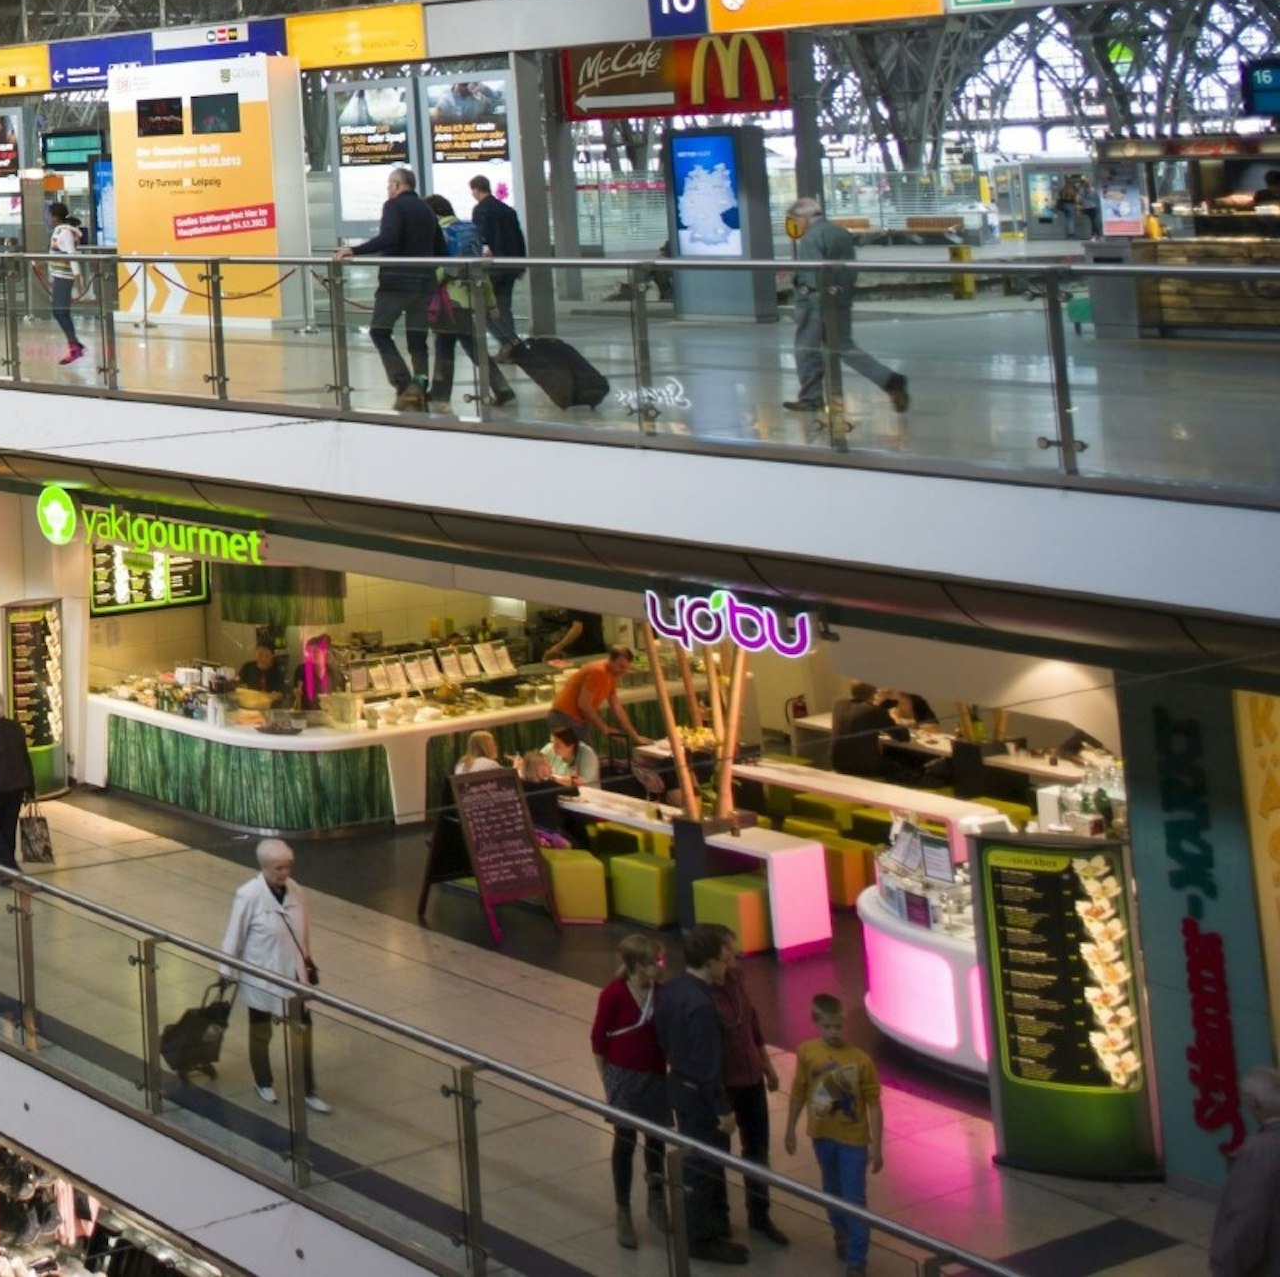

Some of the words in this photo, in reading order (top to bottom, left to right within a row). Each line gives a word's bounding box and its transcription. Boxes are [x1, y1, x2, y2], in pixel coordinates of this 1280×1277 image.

[578, 41, 662, 88] McCafé
[1253, 70, 1273, 84] 16
[81, 504, 262, 565] yakigourmet
